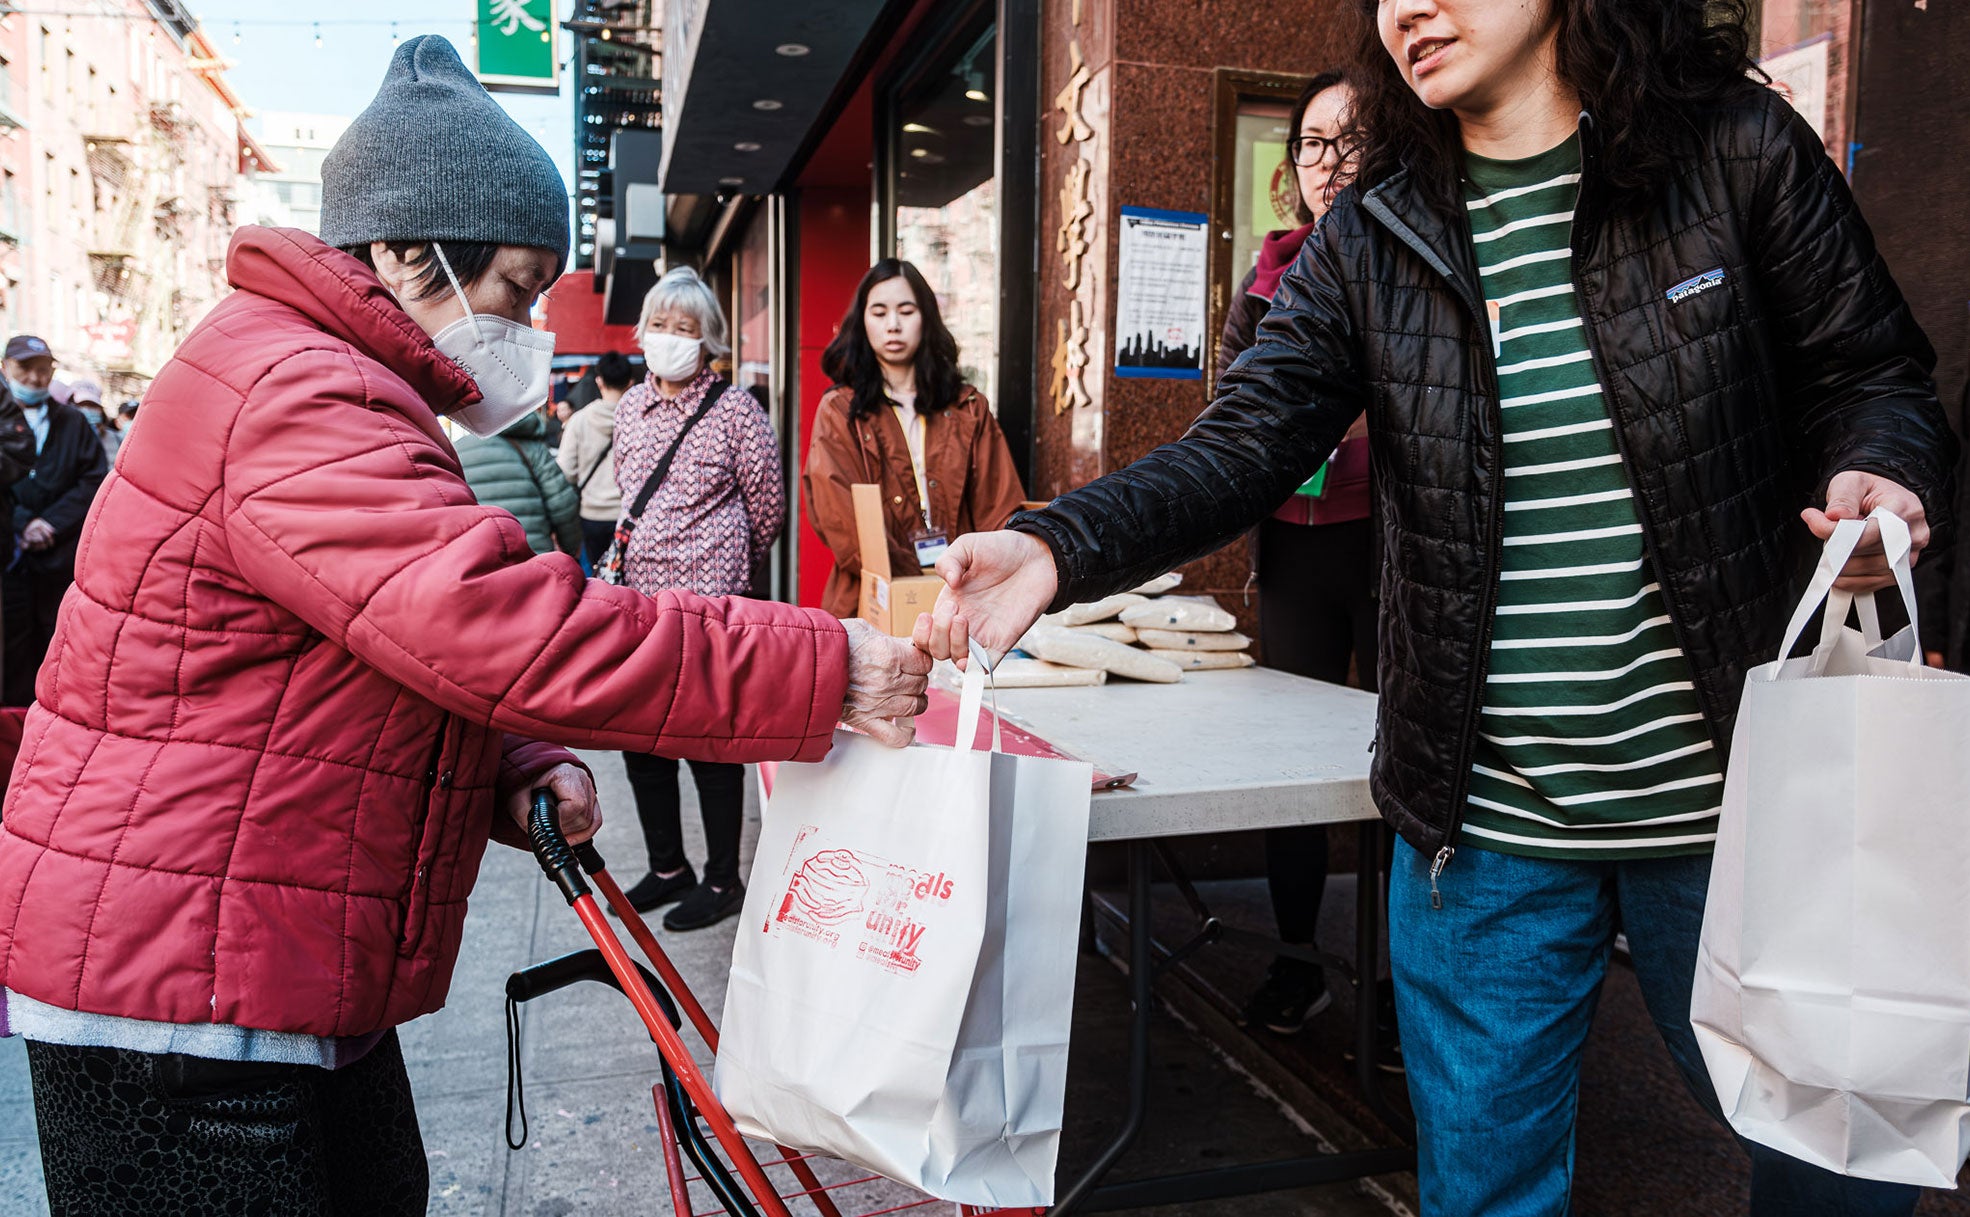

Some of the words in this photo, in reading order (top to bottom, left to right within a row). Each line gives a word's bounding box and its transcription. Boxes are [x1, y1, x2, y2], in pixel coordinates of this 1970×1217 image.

[1049, 0, 1094, 415] 文學校
[1671, 277, 1723, 304] patagonia
